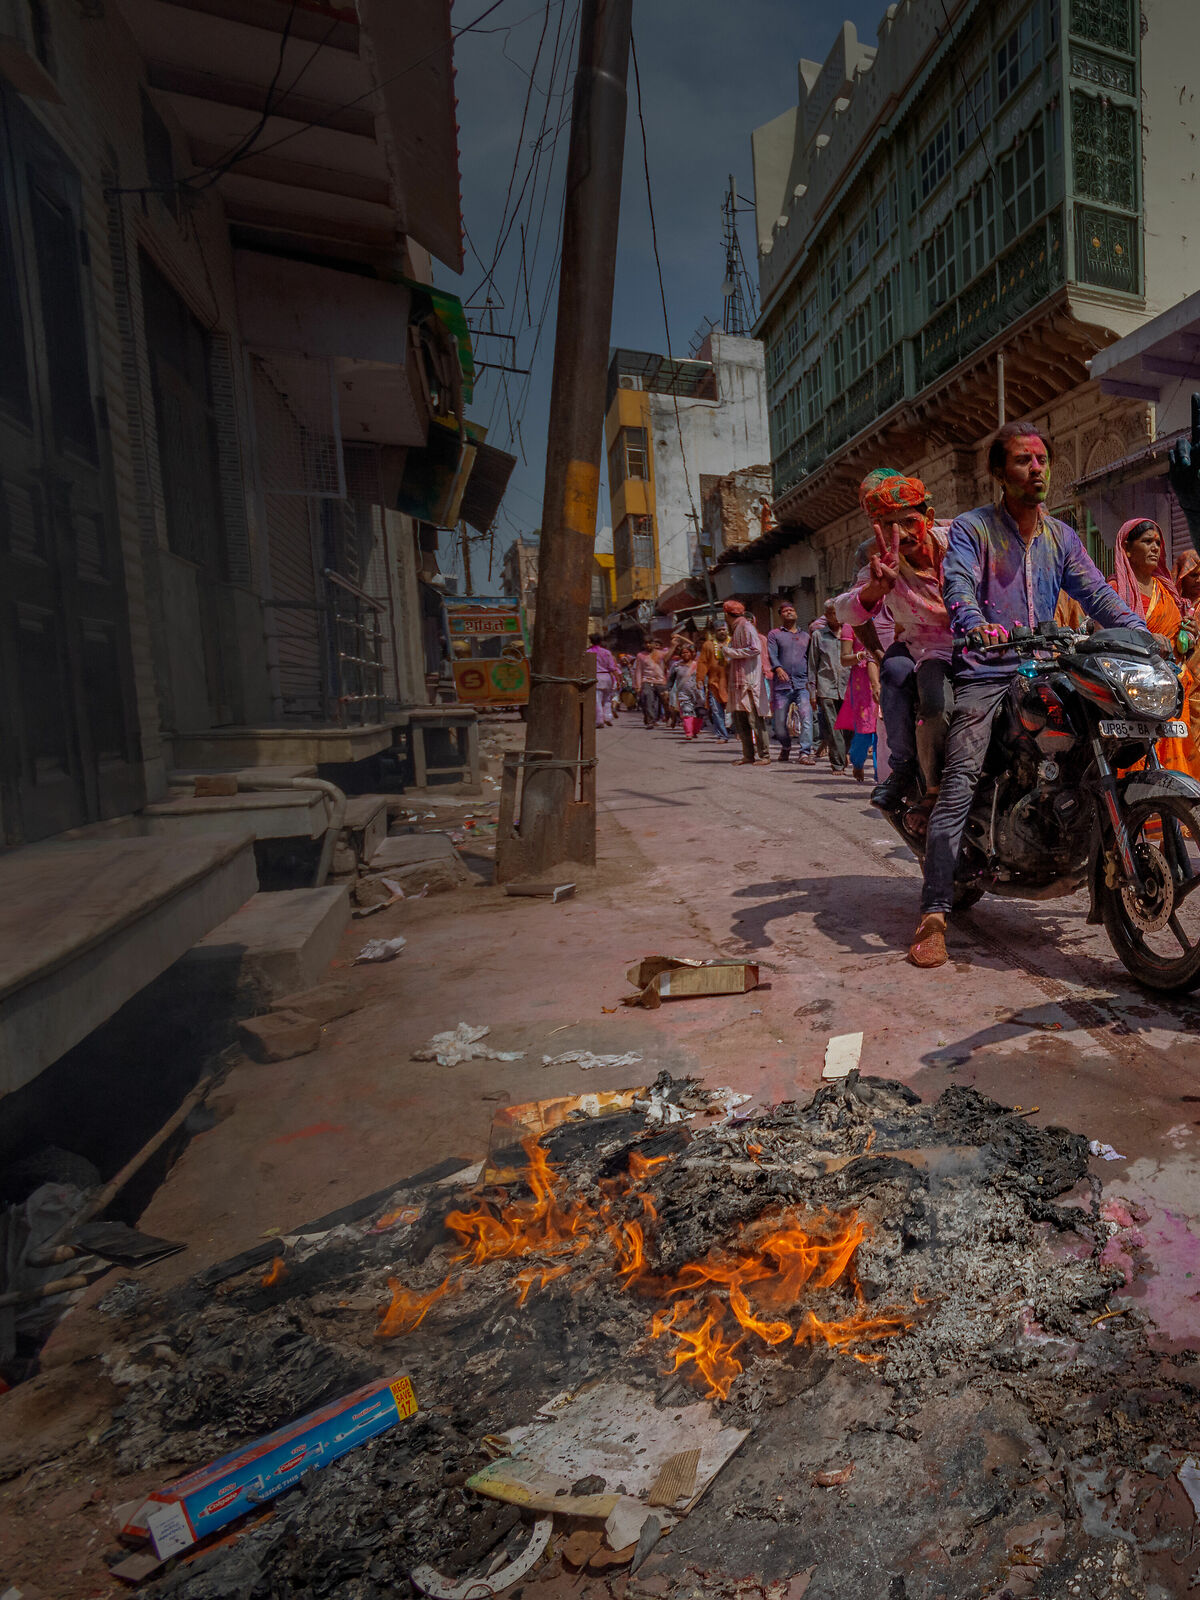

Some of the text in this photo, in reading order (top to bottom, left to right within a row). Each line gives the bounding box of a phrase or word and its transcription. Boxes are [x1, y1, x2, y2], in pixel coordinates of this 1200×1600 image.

[391, 1379, 410, 1395] MEGA
[396, 1389, 412, 1405] SAVE
[401, 1400, 411, 1417] 17
[207, 1492, 238, 1511] Colgate
